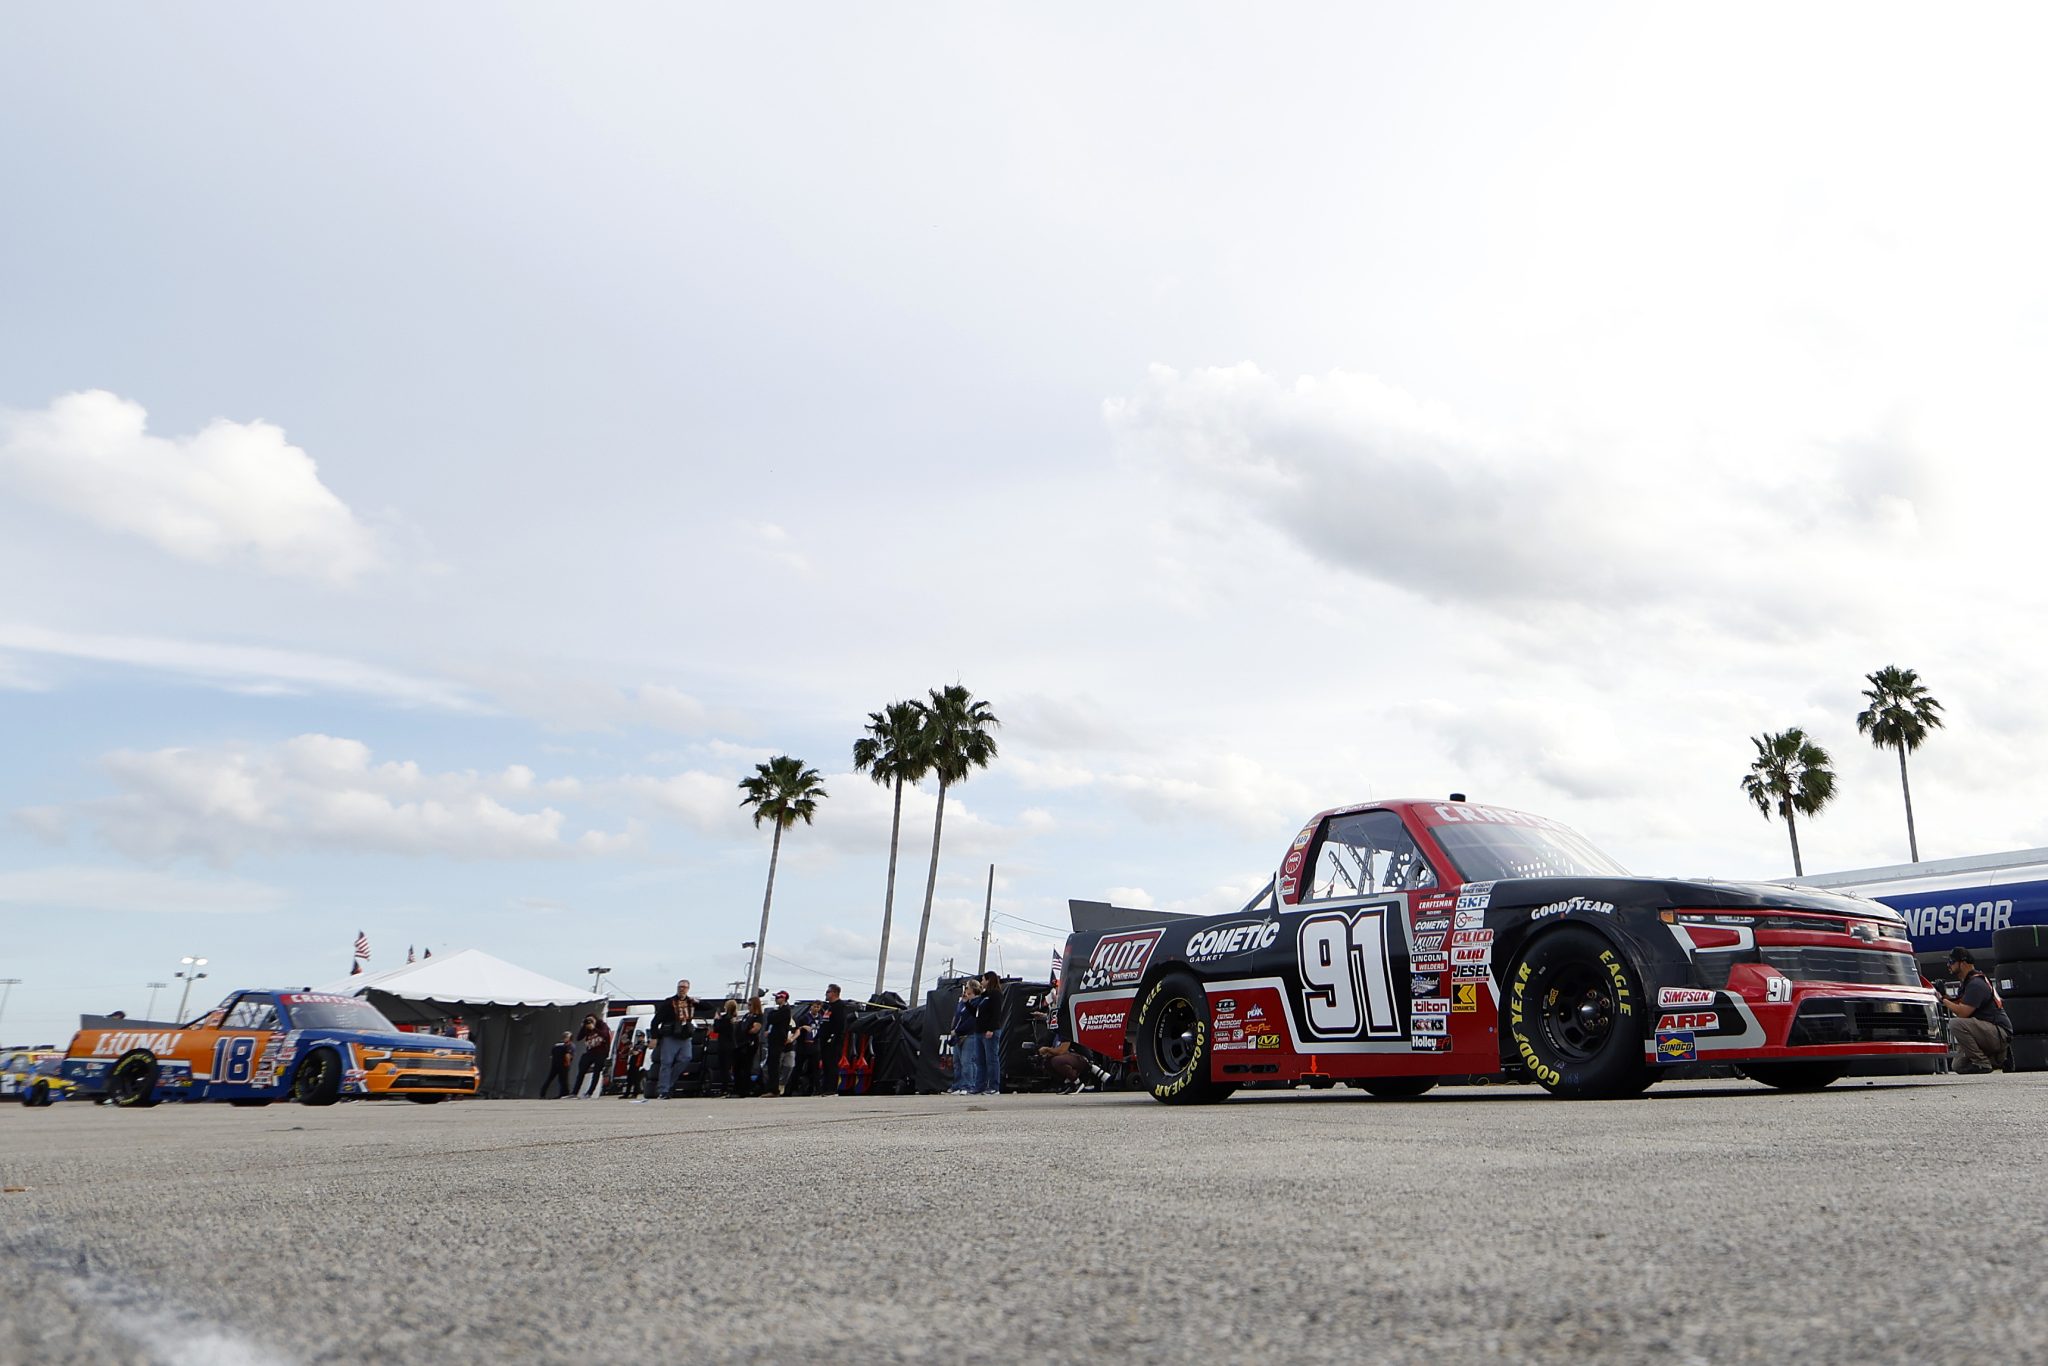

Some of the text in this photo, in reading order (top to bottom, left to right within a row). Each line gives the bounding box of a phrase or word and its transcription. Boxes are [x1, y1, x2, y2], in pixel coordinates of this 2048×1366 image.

[1418, 899, 1453, 910] CRAFTSMAN
[1457, 896, 1489, 908] SKF
[1531, 896, 1614, 920] GOODYEAR
[1414, 919, 1450, 931] COMETIC
[1903, 900, 2013, 937] NASCAR
[1185, 921, 1281, 958] COMETIC
[1416, 935, 1443, 947] KLOTZ
[1454, 930, 1493, 943] CALICO
[1092, 938, 1154, 973] KLOTZ
[1189, 953, 1224, 963] GASKET
[1412, 954, 1442, 962] LINCOLN
[1112, 971, 1139, 981] SYNTHETICS
[1296, 905, 1402, 1039] 91
[1452, 964, 1491, 978] JESEL
[1599, 949, 1633, 1017] EAGLE
[1766, 976, 1793, 1003] 91
[1139, 980, 1163, 1025] EAGLE
[1662, 990, 1710, 1004] SIMPSON
[1413, 1000, 1448, 1012] tilton
[1087, 1012, 1126, 1025] INSTACOAT
[1511, 961, 1560, 1086] GOODYEAR
[1657, 1013, 1717, 1029] ARP
[1412, 1035, 1437, 1051] Holley
[1659, 1042, 1693, 1052] SUNOCO
[209, 1036, 256, 1084] 18
[1155, 1021, 1205, 1097] GOODYEAR
